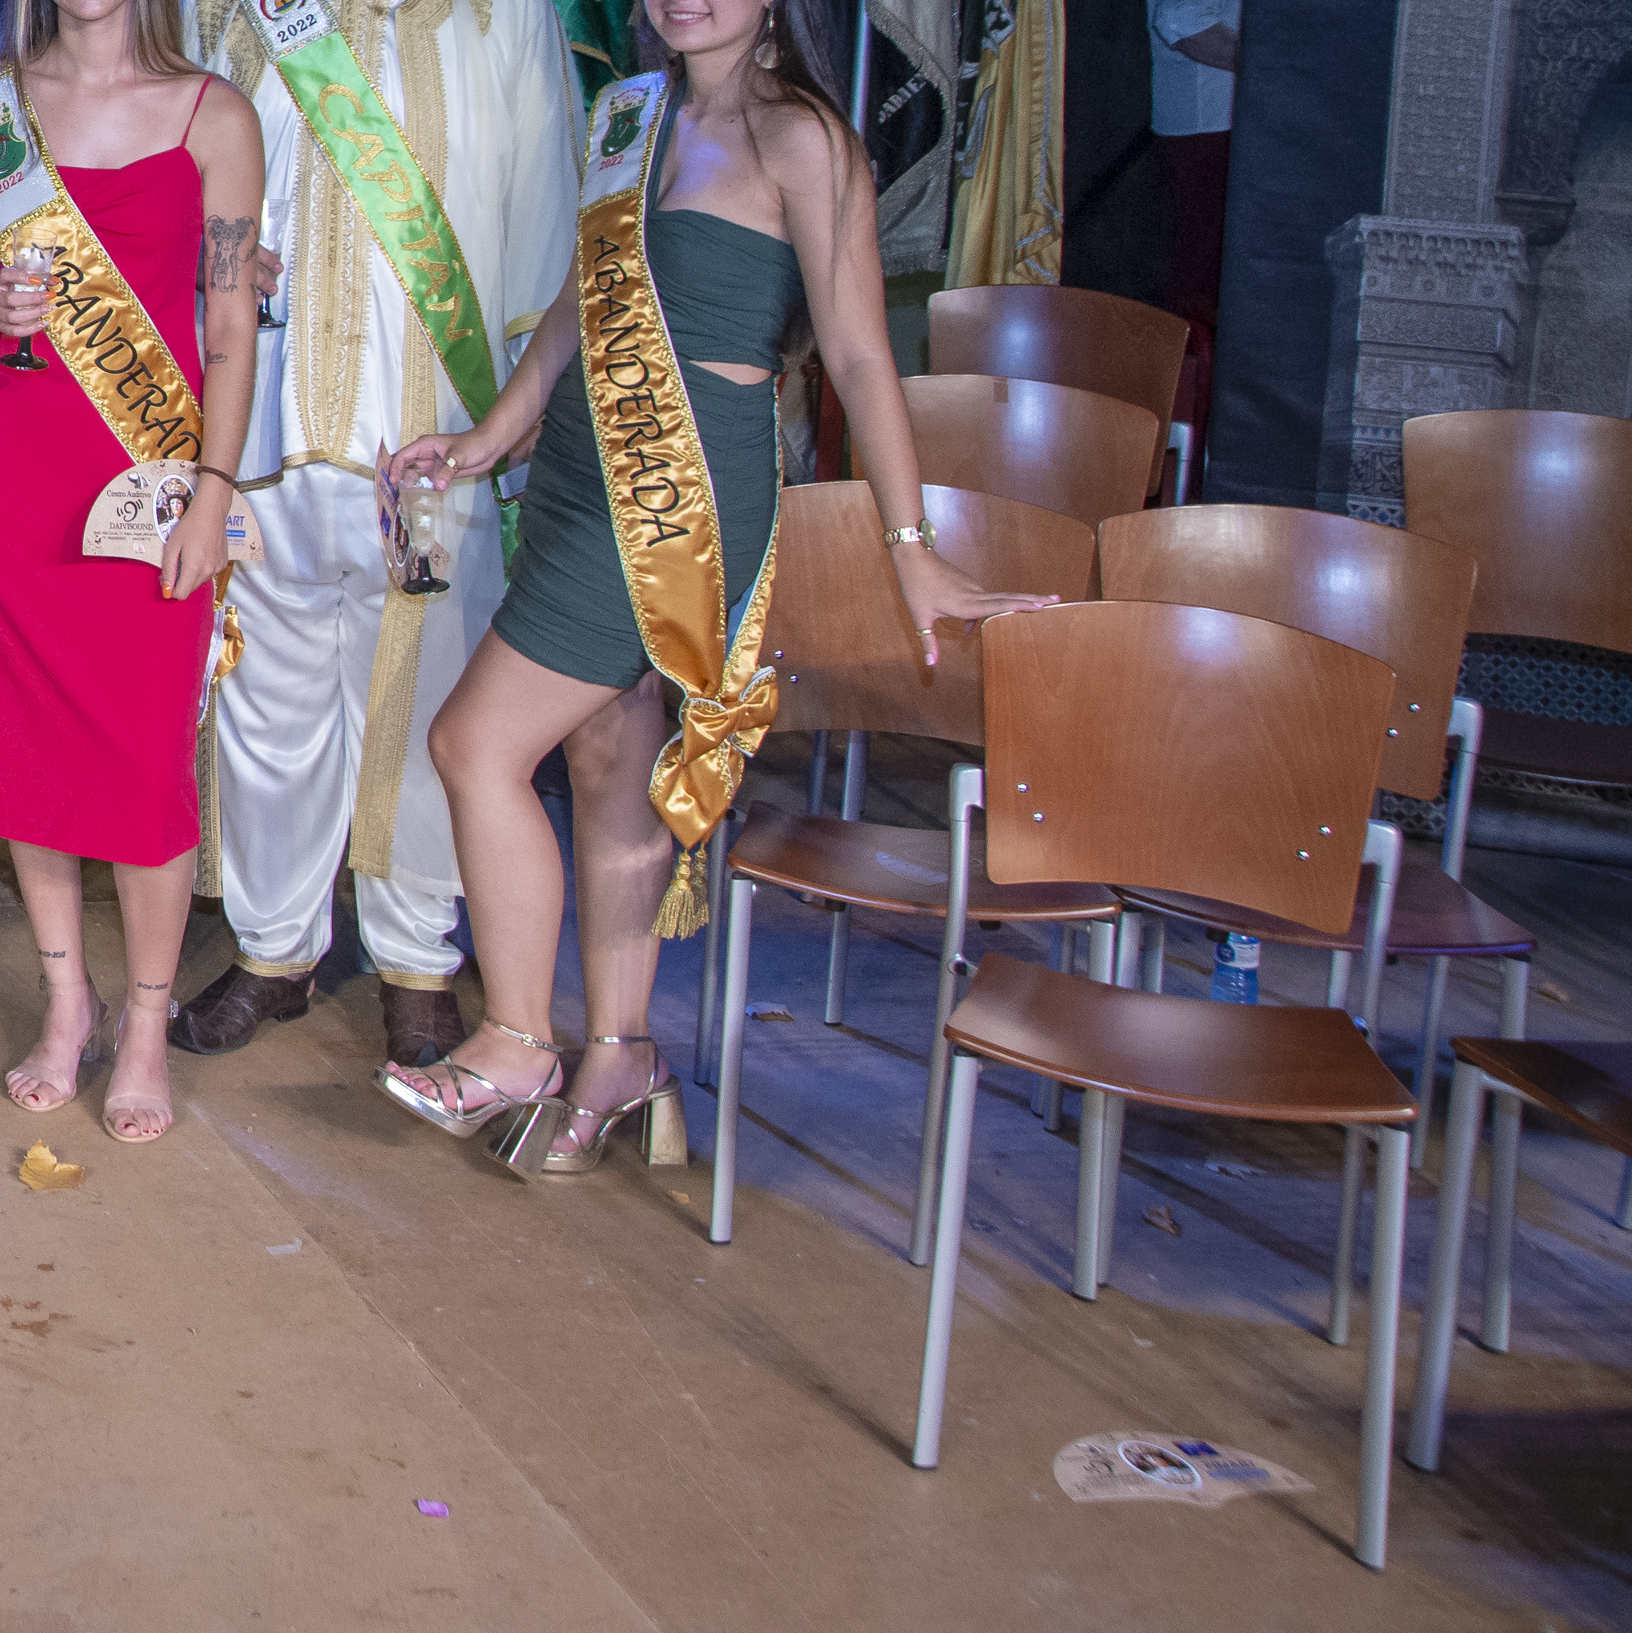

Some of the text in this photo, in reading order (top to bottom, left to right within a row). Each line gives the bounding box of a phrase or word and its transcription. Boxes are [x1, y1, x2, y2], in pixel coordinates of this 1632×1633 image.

[277, 13, 317, 43] 2022
[598, 153, 626, 172] 2022
[593, 233, 692, 548] ABANDERADA
[106, 489, 151, 499] Centro Auditivo
